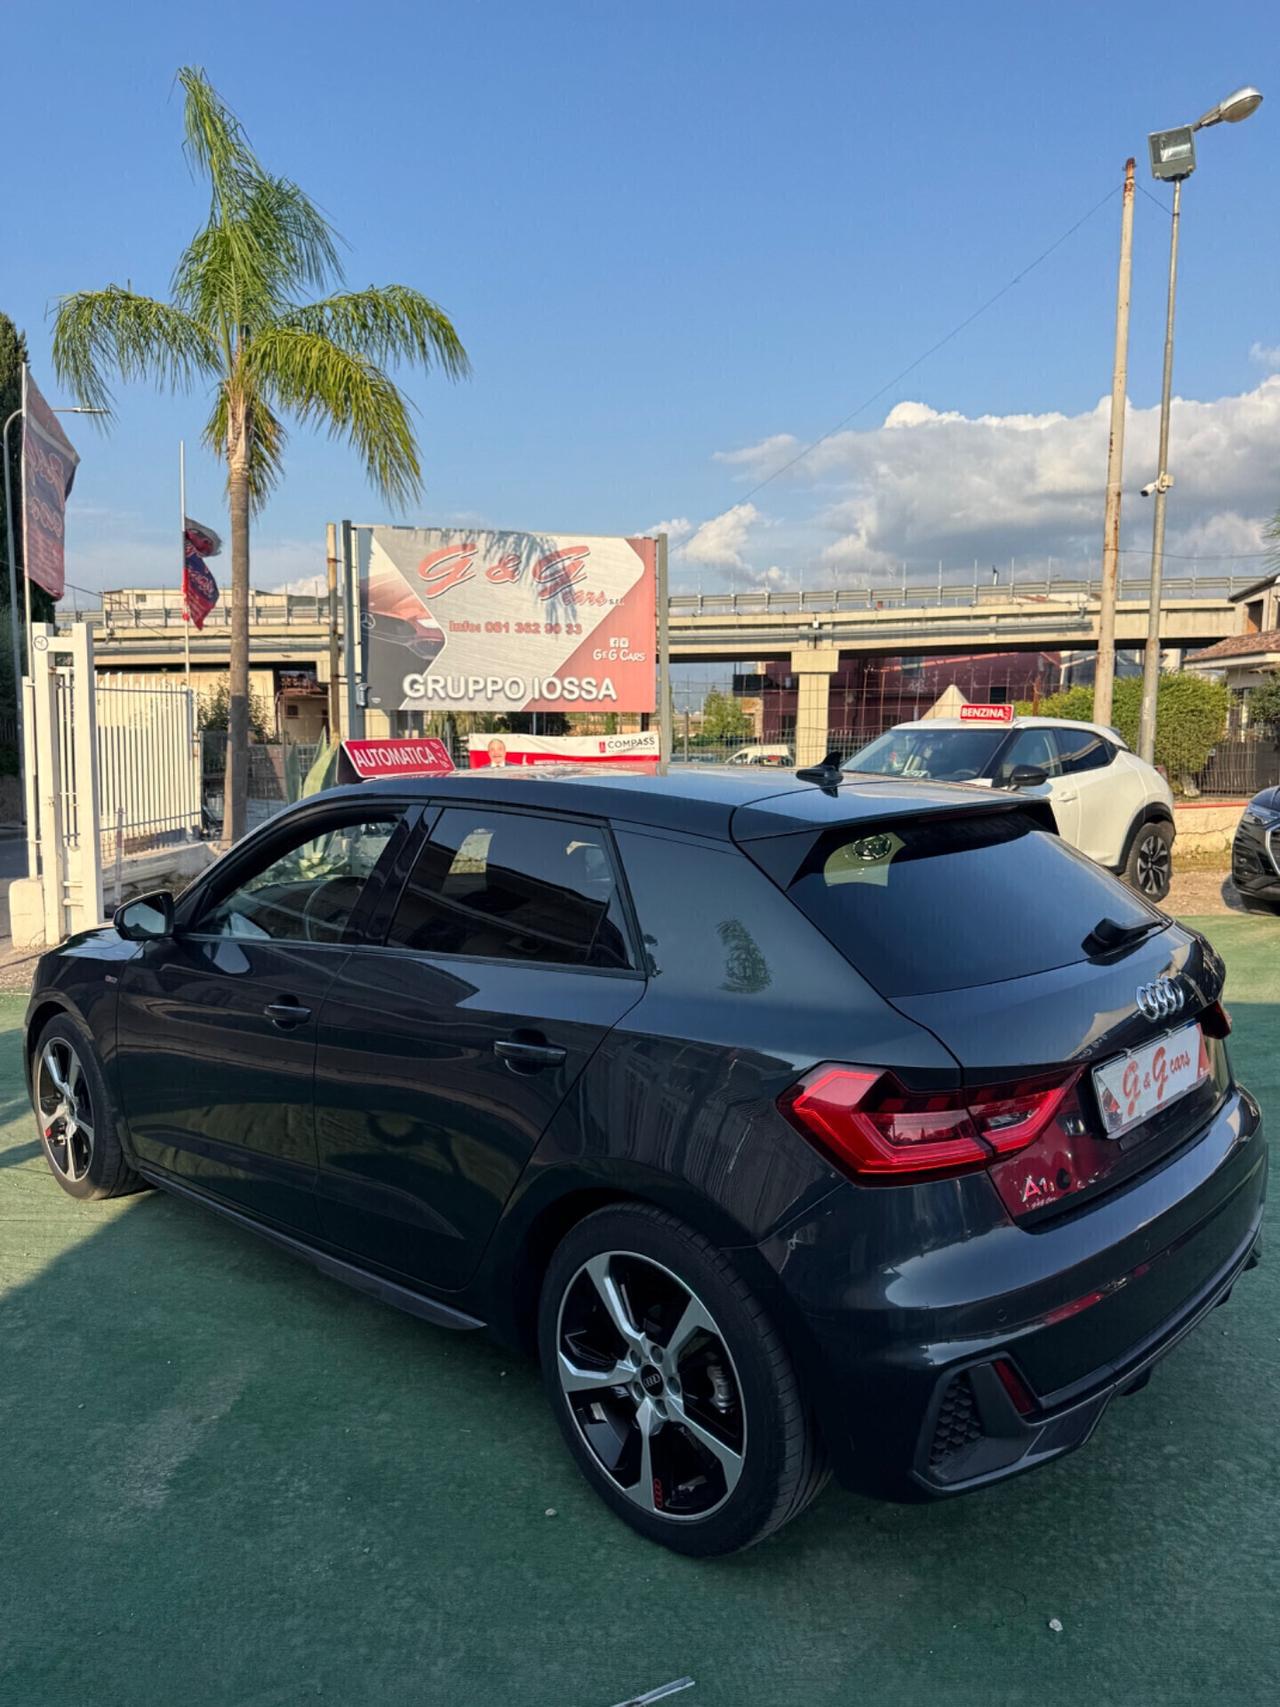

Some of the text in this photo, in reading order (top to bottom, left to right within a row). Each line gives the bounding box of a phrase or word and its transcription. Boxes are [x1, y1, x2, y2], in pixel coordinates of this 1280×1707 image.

[418, 543, 591, 600] G & G
[484, 621, 510, 634] 081
[402, 674, 618, 701] GRUPPO IOSSA
[961, 707, 1004, 718] BENZINA
[607, 737, 656, 750] COMPASS
[353, 746, 438, 768] AUTOMATICA
[1143, 1071, 1151, 1090] &
